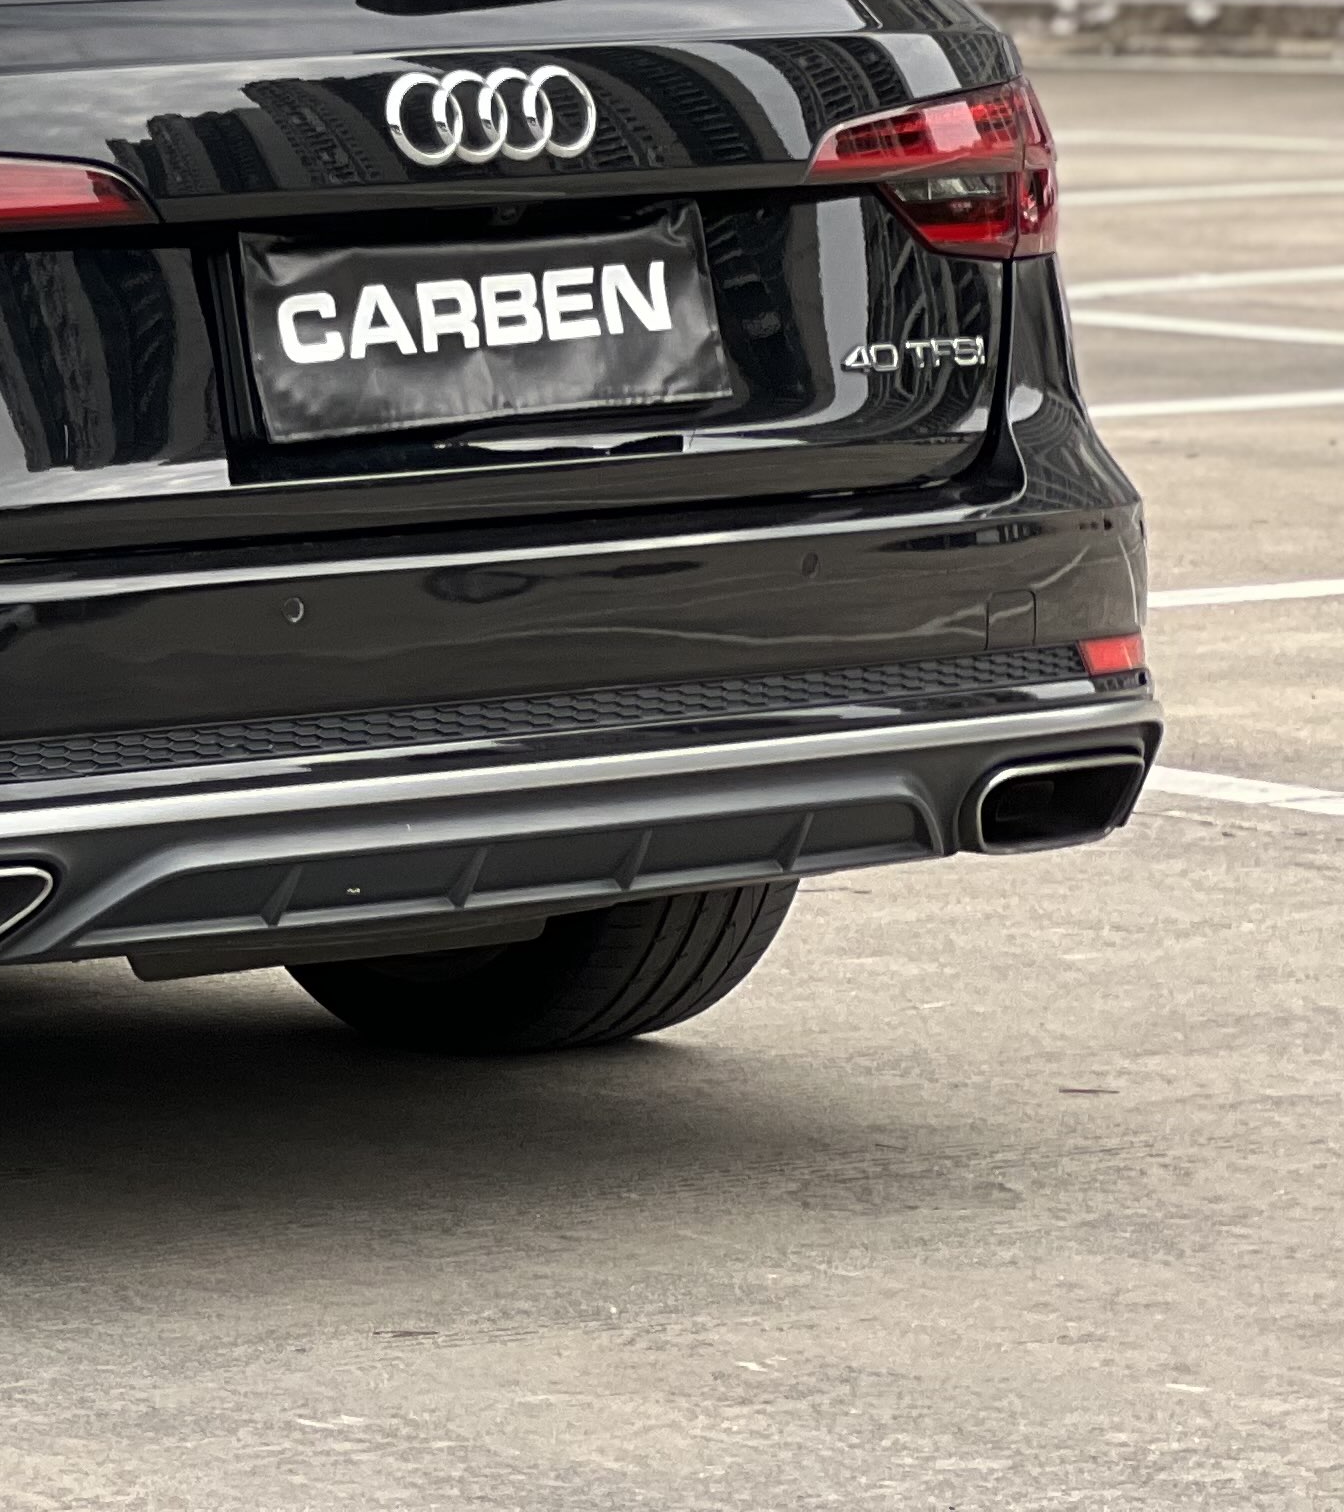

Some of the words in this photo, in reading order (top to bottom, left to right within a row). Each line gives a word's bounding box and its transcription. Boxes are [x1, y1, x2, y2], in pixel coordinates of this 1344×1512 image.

[276, 260, 674, 365] CARBEN
[840, 343, 899, 373] 40
[905, 335, 986, 369] TFSI
